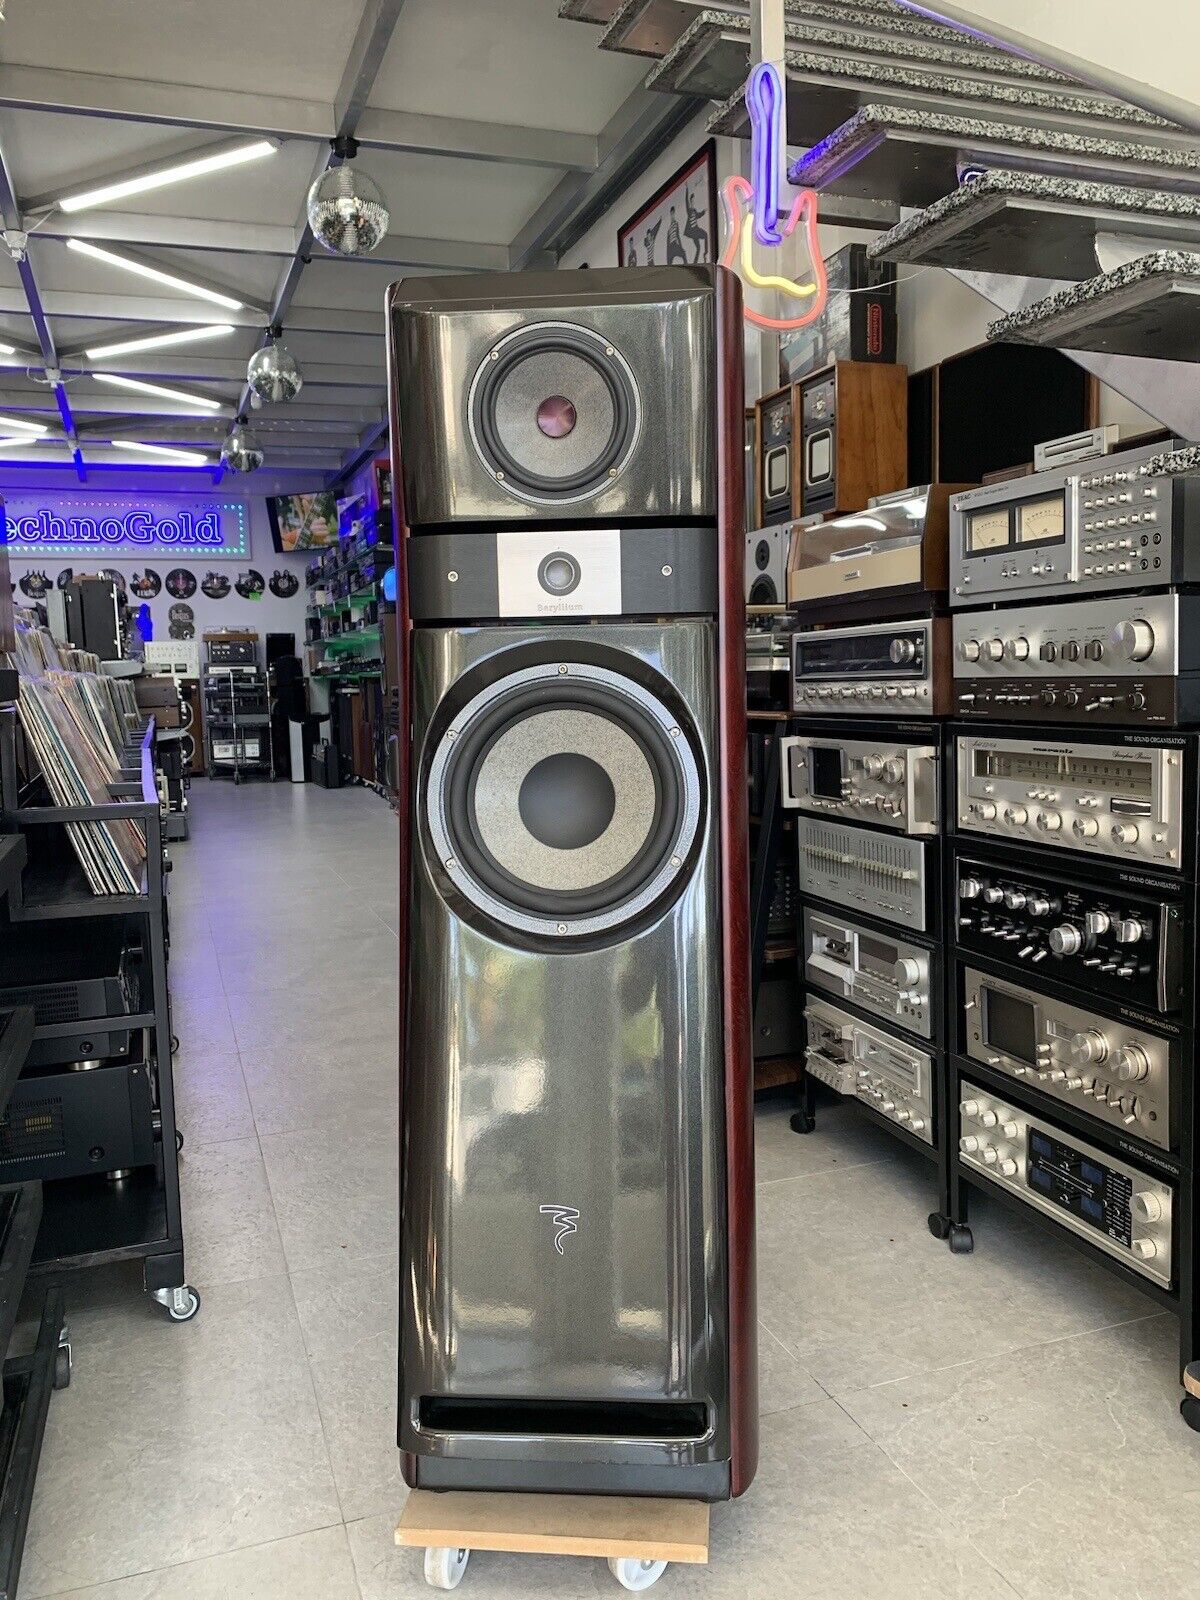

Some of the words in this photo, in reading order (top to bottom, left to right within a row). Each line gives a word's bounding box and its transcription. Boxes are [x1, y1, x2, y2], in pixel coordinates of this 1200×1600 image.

[871, 307, 880, 352] Nintendo
[537, 603, 583, 613] Beryllium
[1120, 873, 1128, 881] THE
[1128, 875, 1145, 884] SOUND
[1144, 878, 1180, 891] ORGANISATION
[1120, 1007, 1129, 1015] THE
[1129, 1011, 1145, 1021] SOUND
[1144, 1016, 1180, 1034] ORGANISATION
[1120, 1140, 1128, 1149] THE
[1128, 1145, 1144, 1157] SOUND
[1143, 1153, 1179, 1175] ORGANISATION
